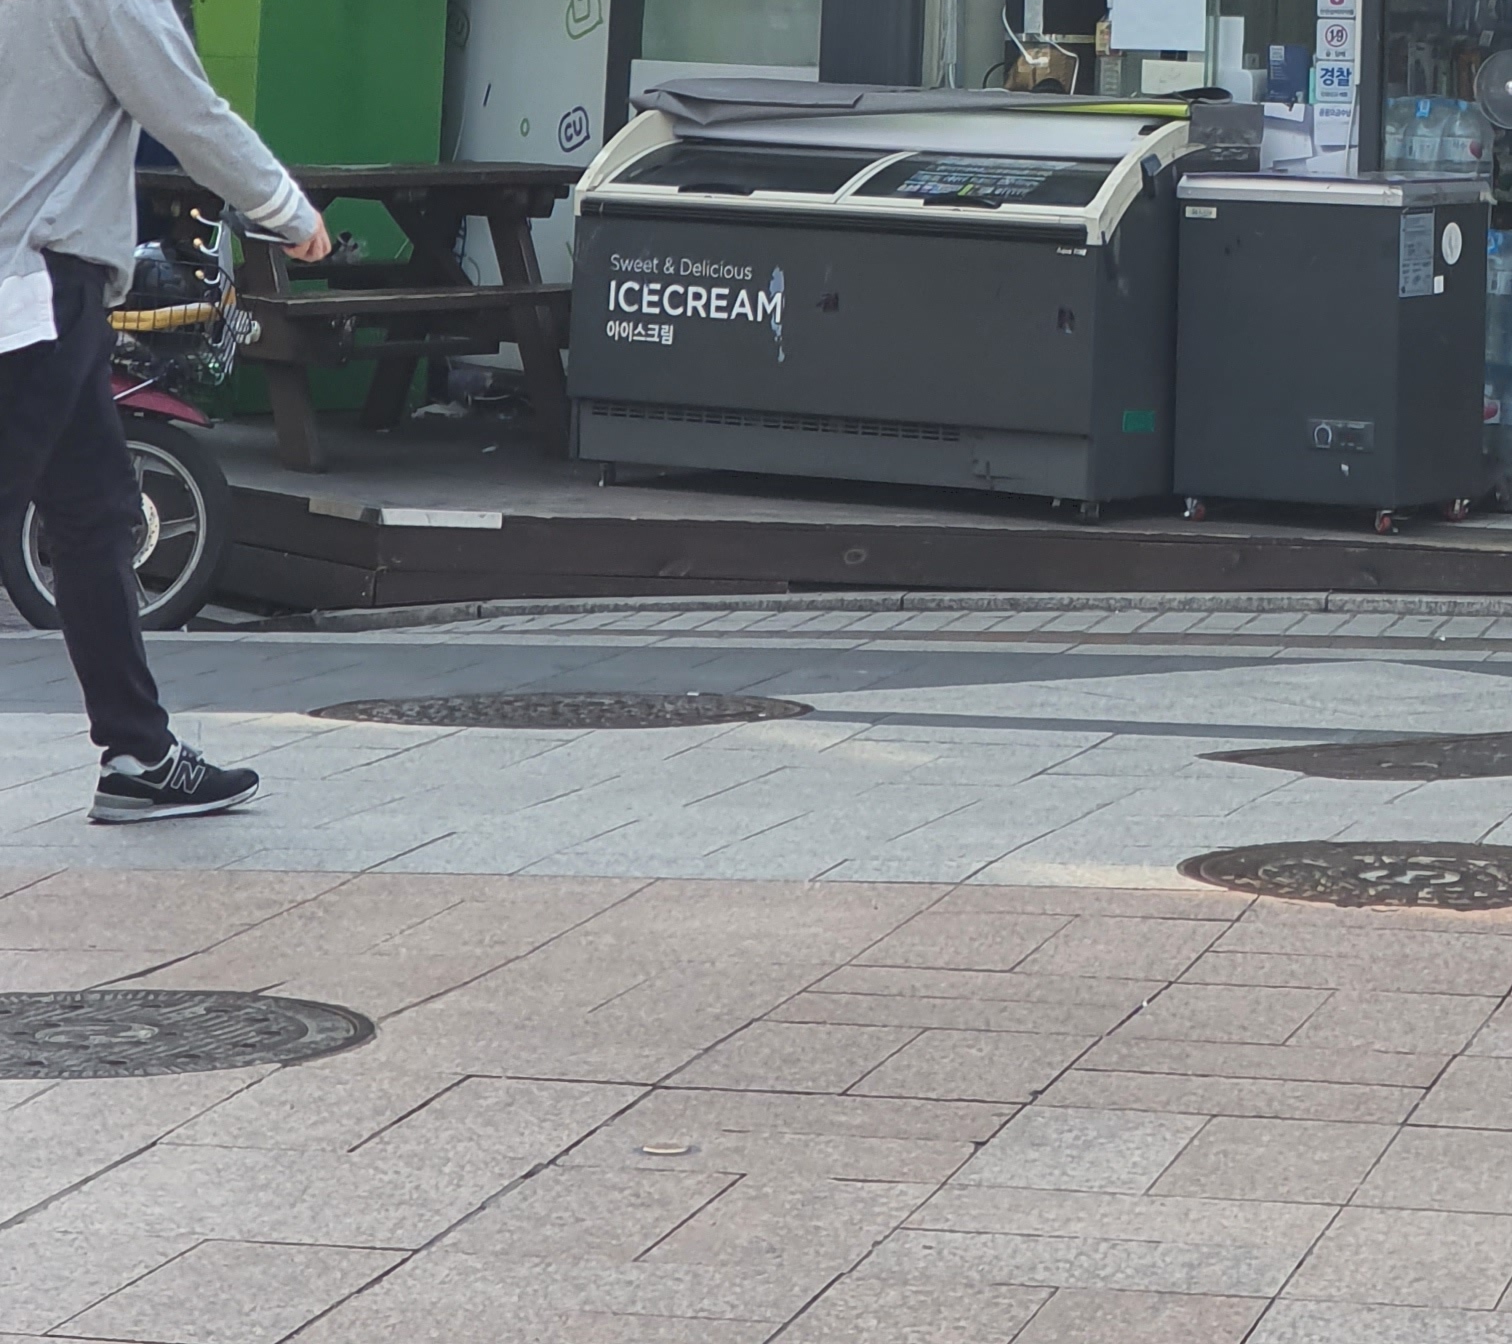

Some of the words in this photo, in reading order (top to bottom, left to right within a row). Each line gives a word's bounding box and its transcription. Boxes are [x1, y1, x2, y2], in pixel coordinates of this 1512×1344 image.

[1319, 67, 1353, 87] 경찰
[564, 116, 583, 143] CU
[610, 253, 659, 274] Sweet
[663, 257, 675, 275] &
[680, 258, 753, 280] Delicious
[608, 280, 782, 324] ICECREAM
[606, 320, 674, 345] 아이스크림
[170, 760, 206, 795] N
